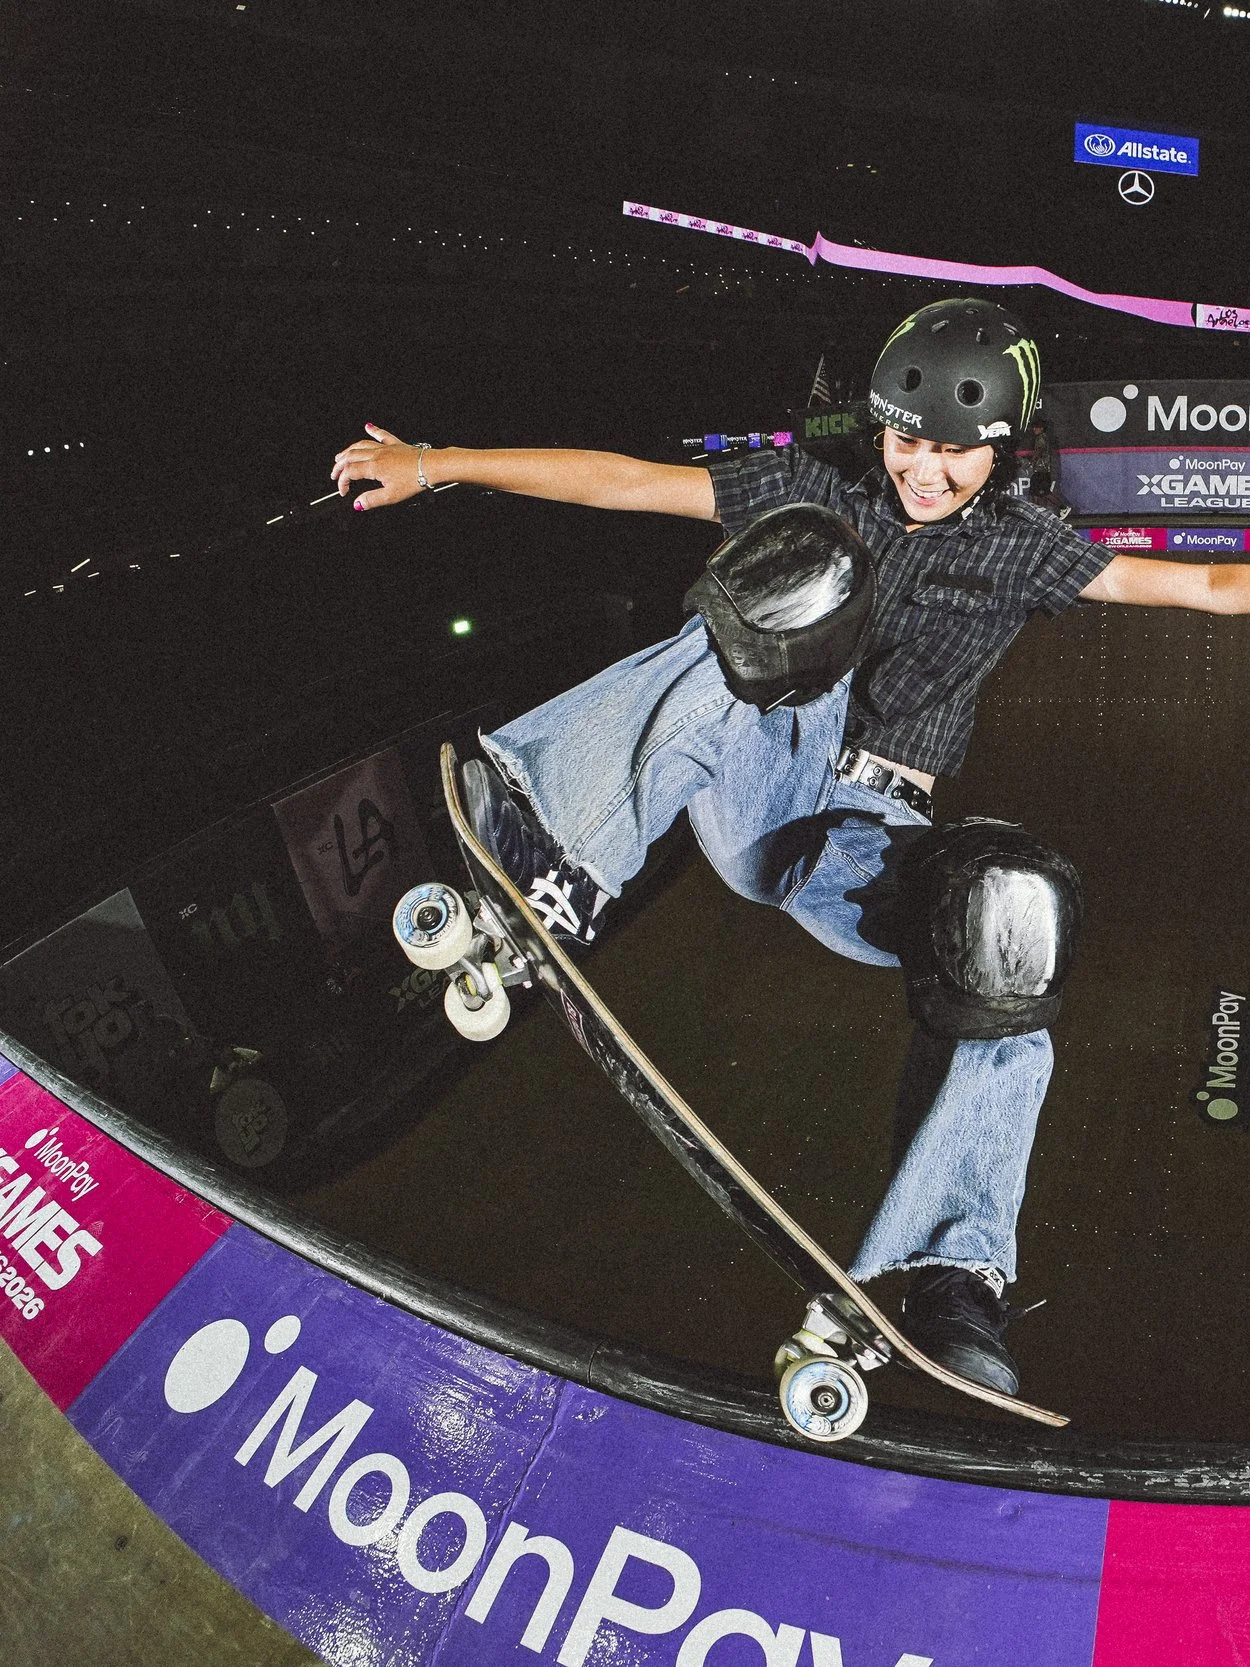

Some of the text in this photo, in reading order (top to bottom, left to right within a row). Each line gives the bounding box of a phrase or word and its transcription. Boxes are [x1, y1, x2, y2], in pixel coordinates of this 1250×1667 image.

[1186, 459, 1246, 473] MoonPay
[1187, 534, 1238, 547] MoonPay
[1206, 990, 1247, 1088] MoonPay
[33, 1137, 100, 1202] MoonPay
[233, 1365, 933, 1667] MoonPa
